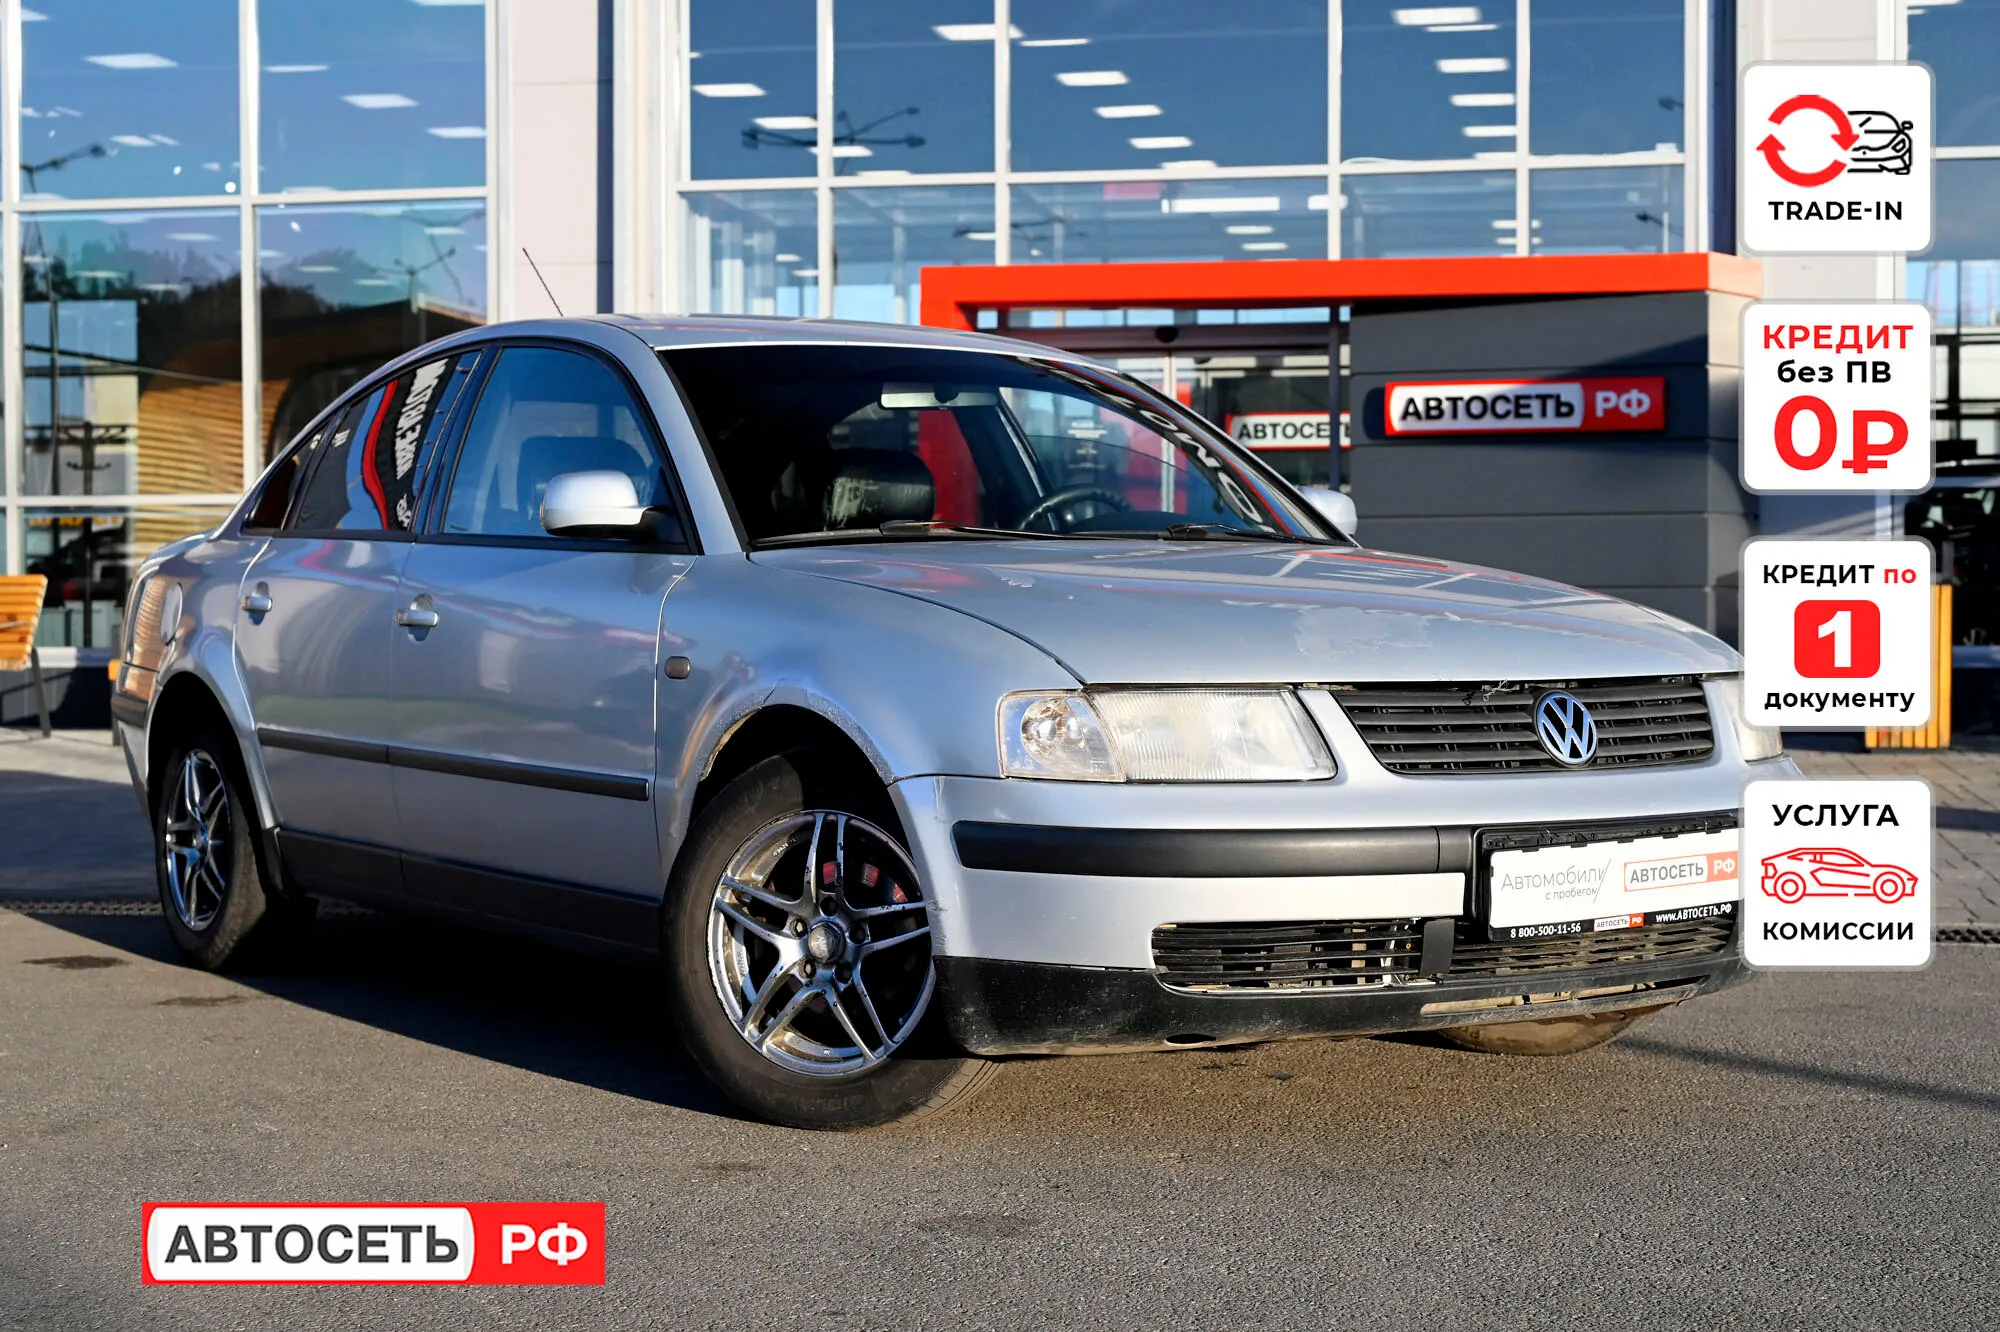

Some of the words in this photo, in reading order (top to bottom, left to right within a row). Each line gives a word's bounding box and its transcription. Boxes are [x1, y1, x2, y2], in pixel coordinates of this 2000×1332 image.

[1401, 393, 1575, 421] АВТОСЕТЬ
[1595, 389, 1651, 418] РФ
[1501, 865, 1605, 892] Автомобили
[1629, 862, 1705, 884] АВТОСЕТЬ
[1713, 857, 1736, 875] РФ
[1545, 892, 1551, 900] с
[1553, 887, 1597, 900] пробегом
[1510, 928, 1517, 938] 8
[1518, 922, 1582, 938] 800-500-11-56
[1596, 918, 1629, 928] АВТОСЕТЬ
[1631, 916, 1642, 925] РФ
